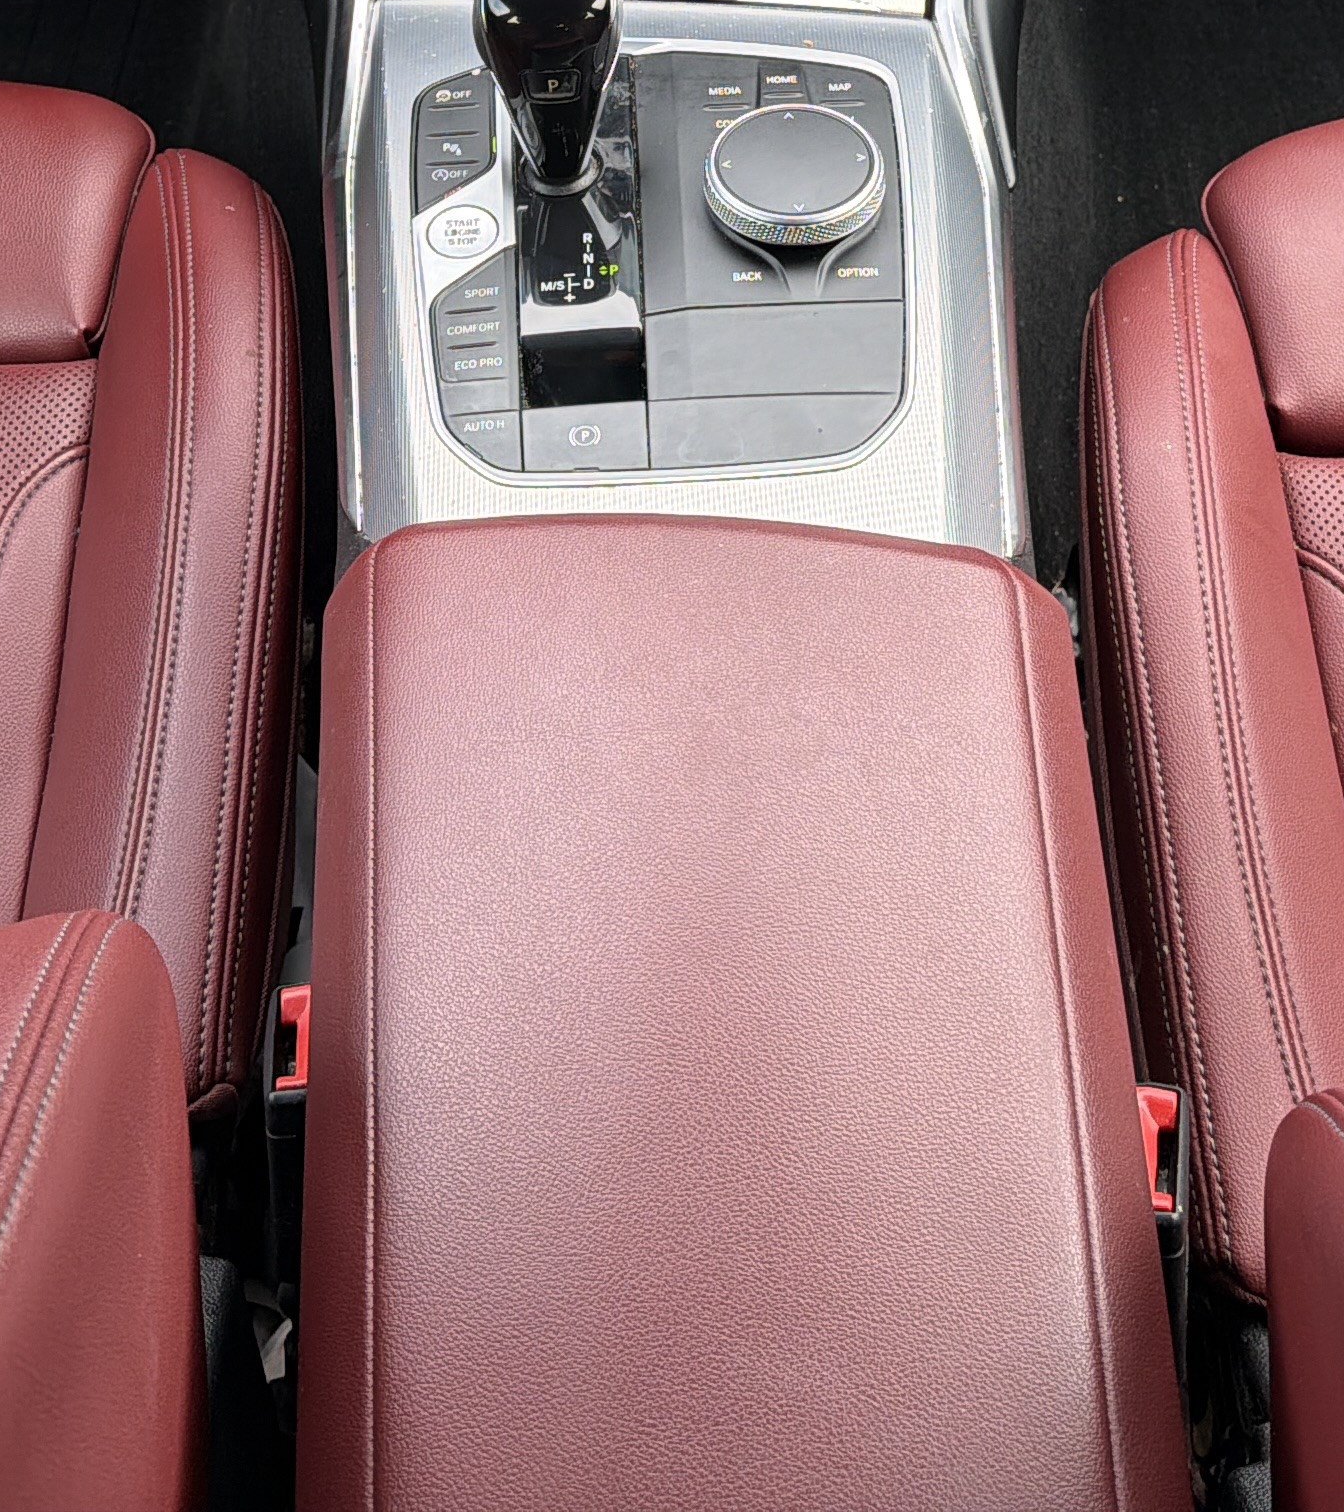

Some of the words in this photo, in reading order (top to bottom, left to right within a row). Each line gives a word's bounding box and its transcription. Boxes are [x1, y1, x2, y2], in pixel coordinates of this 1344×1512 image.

[766, 74, 798, 85] HOME
[547, 79, 559, 93] P
[708, 86, 742, 97] MEDIA
[828, 82, 852, 92] MAP
[452, 90, 472, 100] OFF
[715, 118, 734, 129] CO
[449, 169, 469, 179] OFF
[445, 217, 481, 229] START
[447, 236, 478, 246] STOP
[582, 232, 593, 244] R
[582, 252, 594, 264] N
[609, 264, 619, 276] P
[732, 270, 763, 282] BACK
[837, 267, 879, 278] OPTION
[540, 280, 566, 292] M/S
[583, 278, 595, 290] D
[464, 286, 500, 299] SPORT
[446, 321, 501, 336] COMFORT
[454, 358, 477, 371] ECO
[479, 356, 503, 368] PRO
[463, 420, 495, 433] AUTO
[496, 419, 505, 429] H
